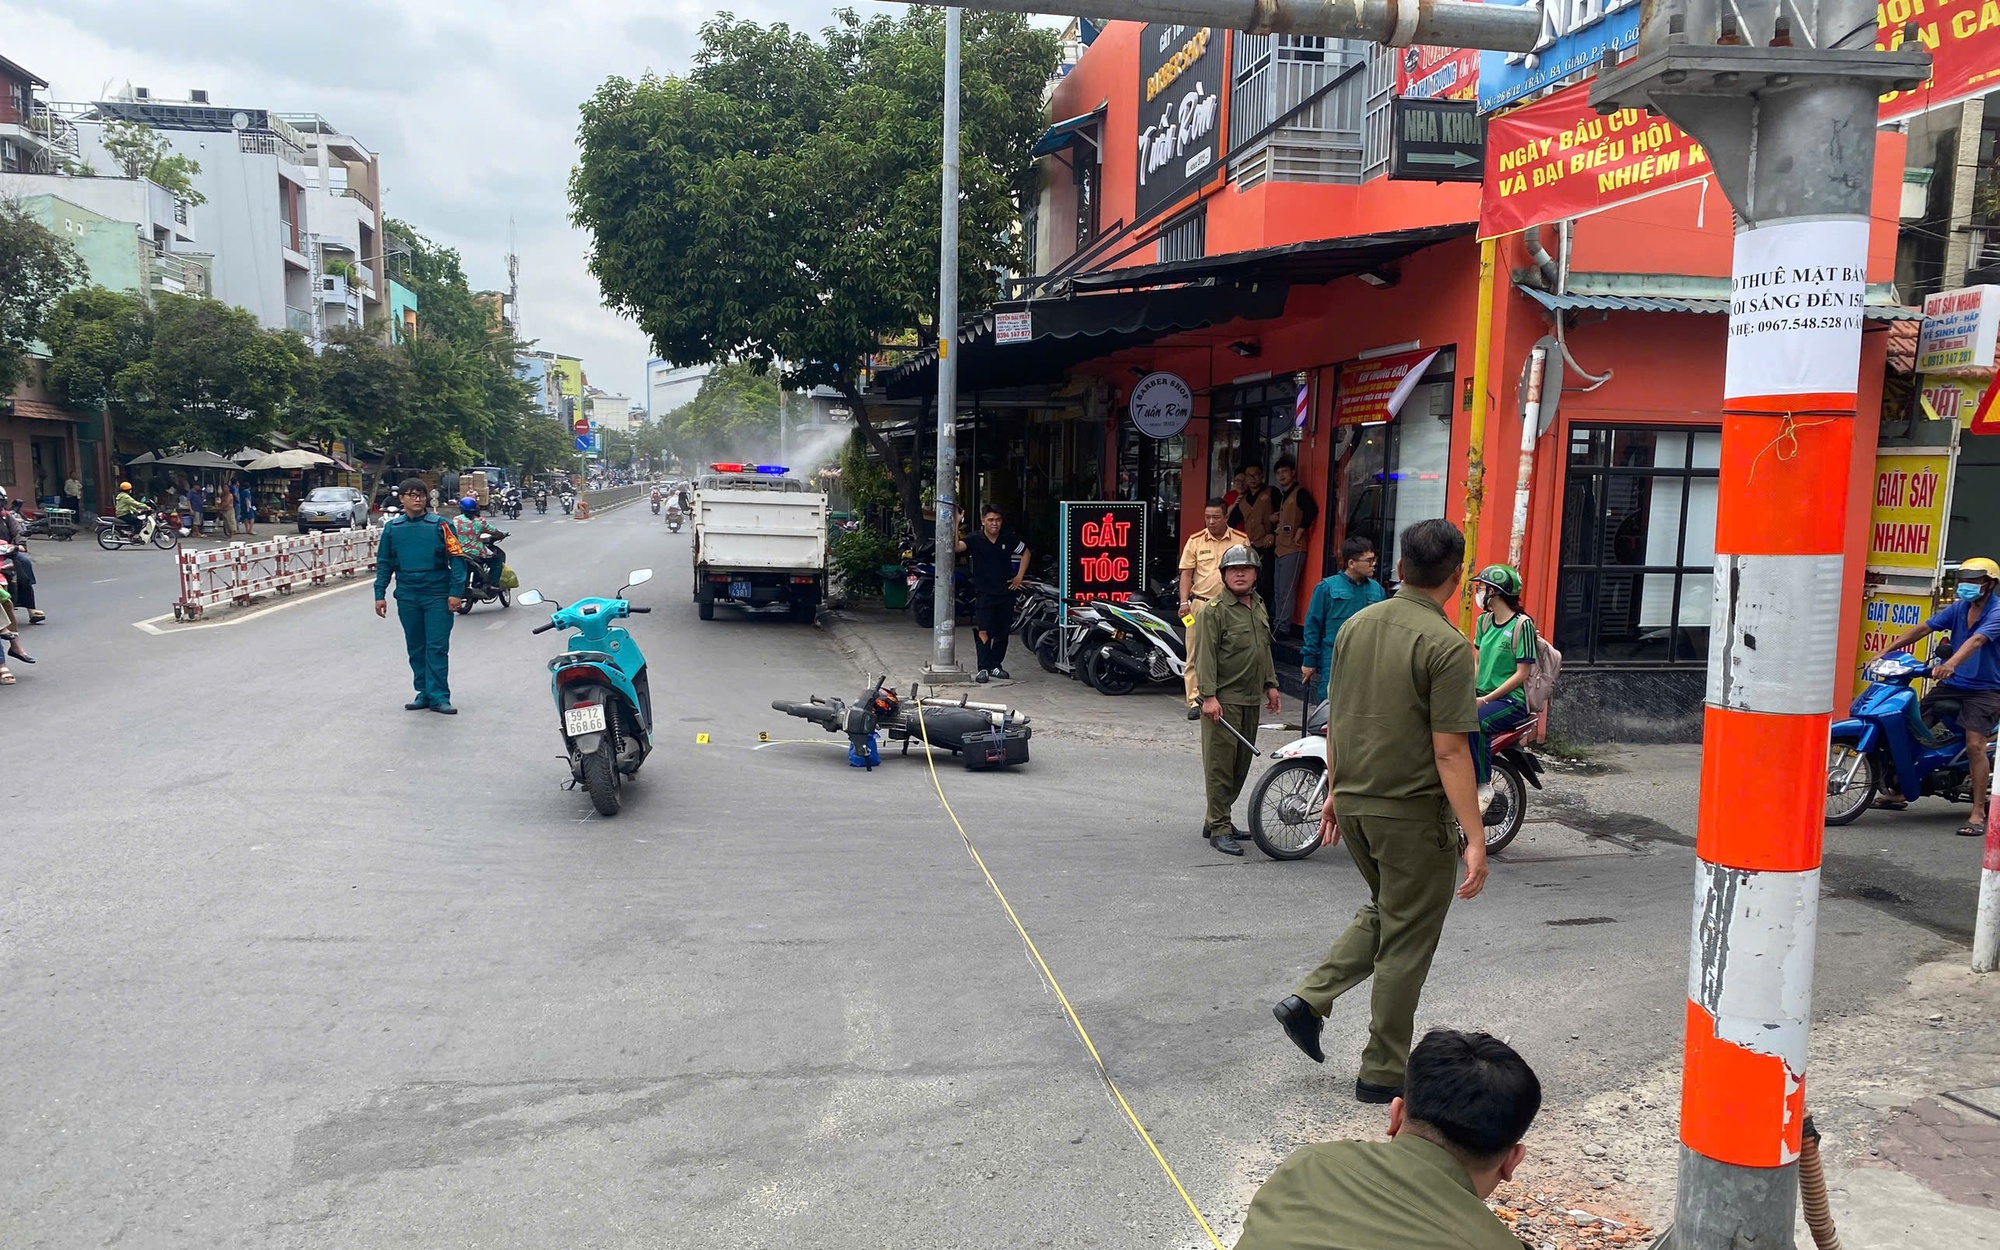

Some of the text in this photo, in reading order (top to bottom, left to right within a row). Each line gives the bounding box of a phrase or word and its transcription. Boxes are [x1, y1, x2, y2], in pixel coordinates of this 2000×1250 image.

[1550, 60, 1562, 80] BÁ
[1564, 51, 1589, 72] GIAO,
[1404, 109, 1483, 145] NHA KHOA
[1498, 121, 1673, 198] VÀ ĐẠI BIỂU HỘI
[1499, 137, 1553, 173] NGÀY
[1558, 118, 1603, 152] BẦU
[1598, 155, 1681, 194] NHIỆM
[1740, 266, 1786, 290] THUÊ
[1792, 266, 1839, 286] MẶT
[1749, 293, 1800, 313] SÁNG
[1806, 289, 1845, 308] ĐẾN
[1957, 291, 1982, 312] NHANH
[1758, 316, 1842, 333] 0967.548.528
[1935, 328, 1955, 338] SINH
[1136, 378, 1189, 401] BARBER SHOP
[1136, 403, 1188, 419] Tuấn Ròm
[1876, 465, 1939, 512] GIẶT SẤY
[1081, 512, 1131, 547] CẮT
[1872, 522, 1931, 554] NHANH
[1080, 552, 1129, 582] TÓC
[1867, 599, 1920, 627] GIẶT SẠCH
[1863, 626, 1888, 652] SẤY
[570, 718, 603, 734] 668.66
